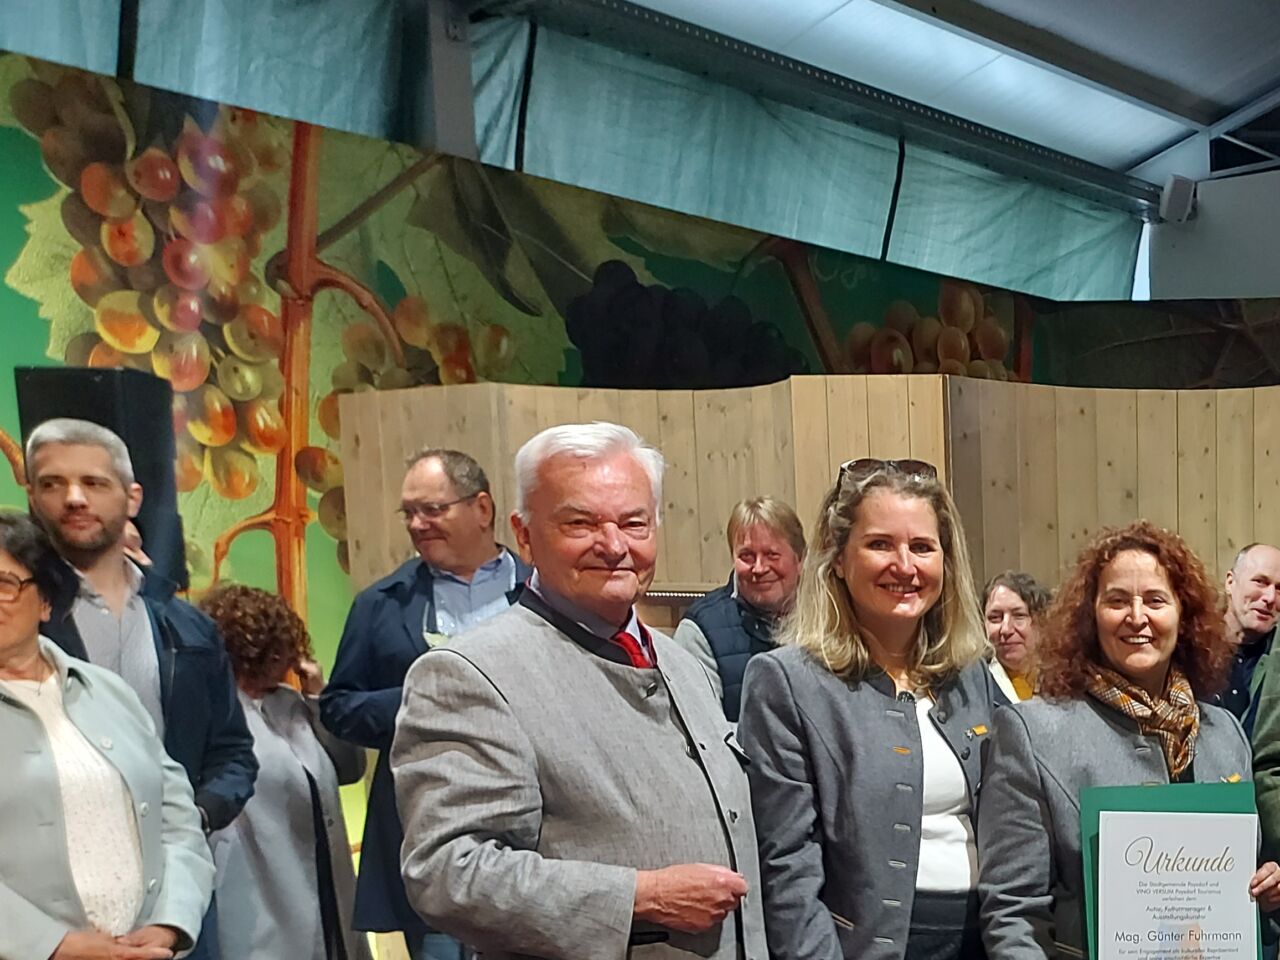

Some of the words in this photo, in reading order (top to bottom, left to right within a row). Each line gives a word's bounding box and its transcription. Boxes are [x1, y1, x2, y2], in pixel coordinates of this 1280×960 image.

[1125, 836, 1235, 875] Urkunde
[1114, 931, 1143, 944] Mag.
[1147, 930, 1184, 942] Günter
[1188, 929, 1242, 942] Fuhrmann
